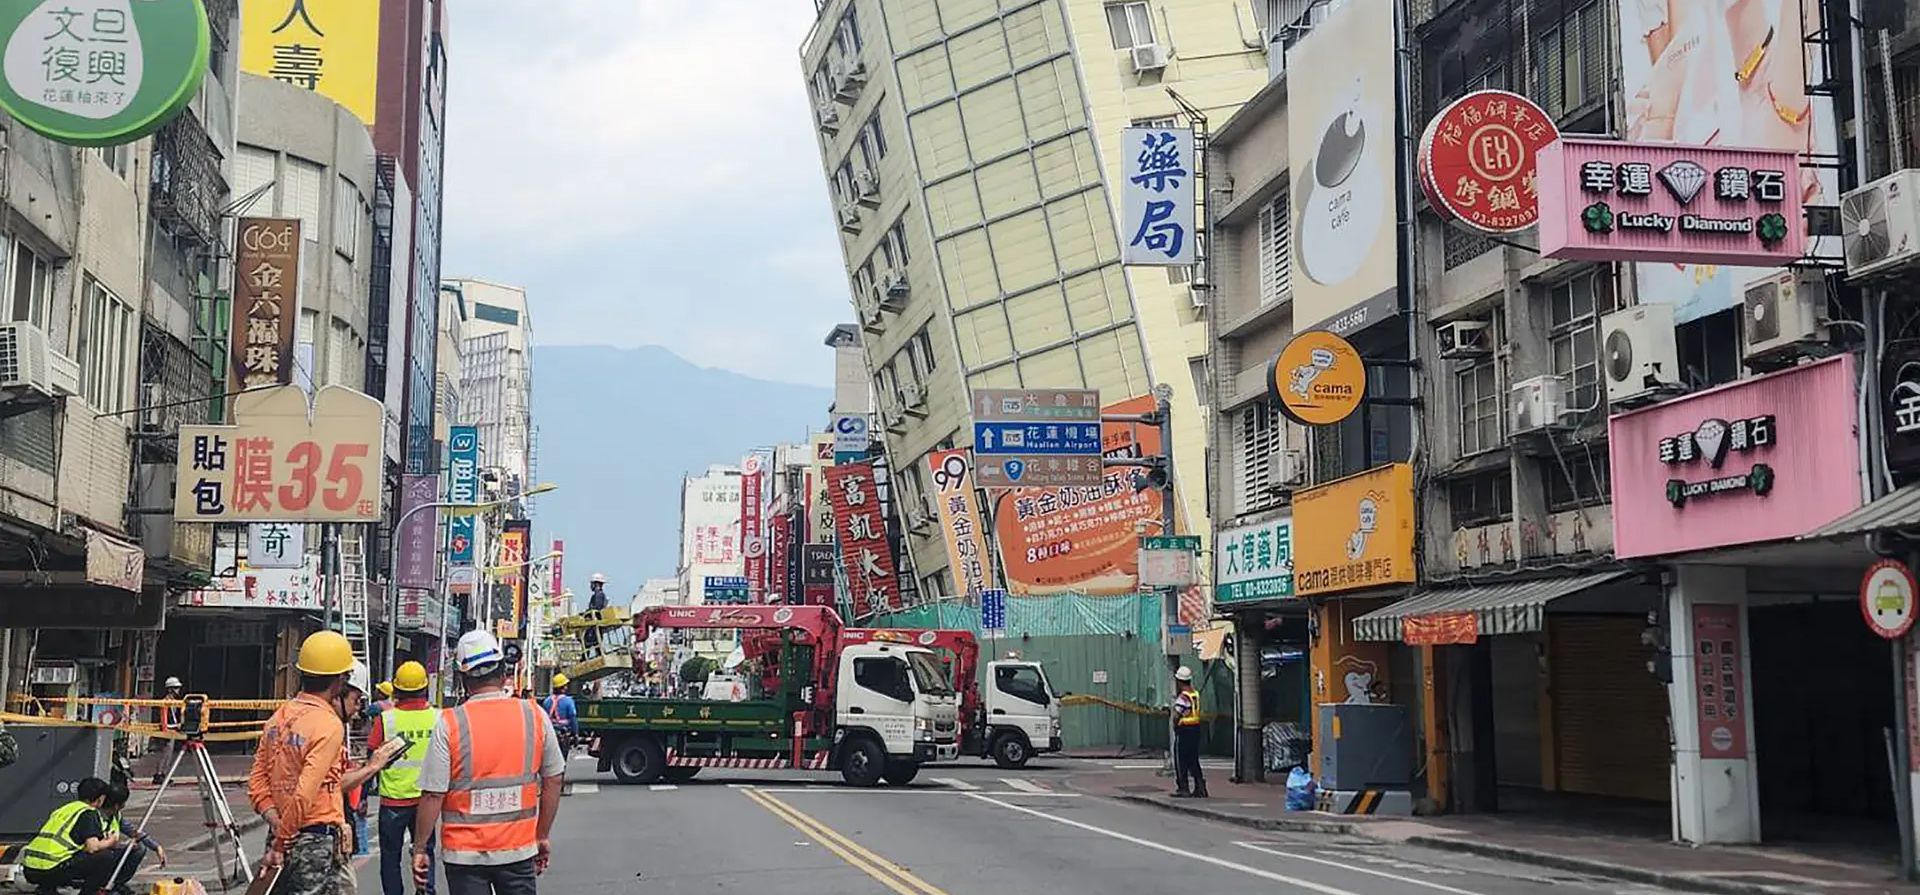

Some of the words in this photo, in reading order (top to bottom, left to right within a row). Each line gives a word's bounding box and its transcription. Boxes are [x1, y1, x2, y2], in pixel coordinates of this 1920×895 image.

[43, 8, 129, 43] 文旦
[42, 46, 127, 86] 復興
[1584, 162, 1652, 195] 幸運
[1718, 167, 1785, 202] 鑽石
[1130, 132, 1188, 258] 藥局
[1622, 212, 1674, 233] Lucky
[1684, 215, 1753, 235] Diamond
[1313, 383, 1352, 394] cama
[1064, 440, 1098, 450] Airport
[1659, 432, 1693, 463] 幸運
[1010, 462, 1019, 474] 9
[1682, 481, 1709, 497] LUCKY
[1710, 475, 1747, 491] DIAMOND
[669, 610, 695, 618] UNIC
